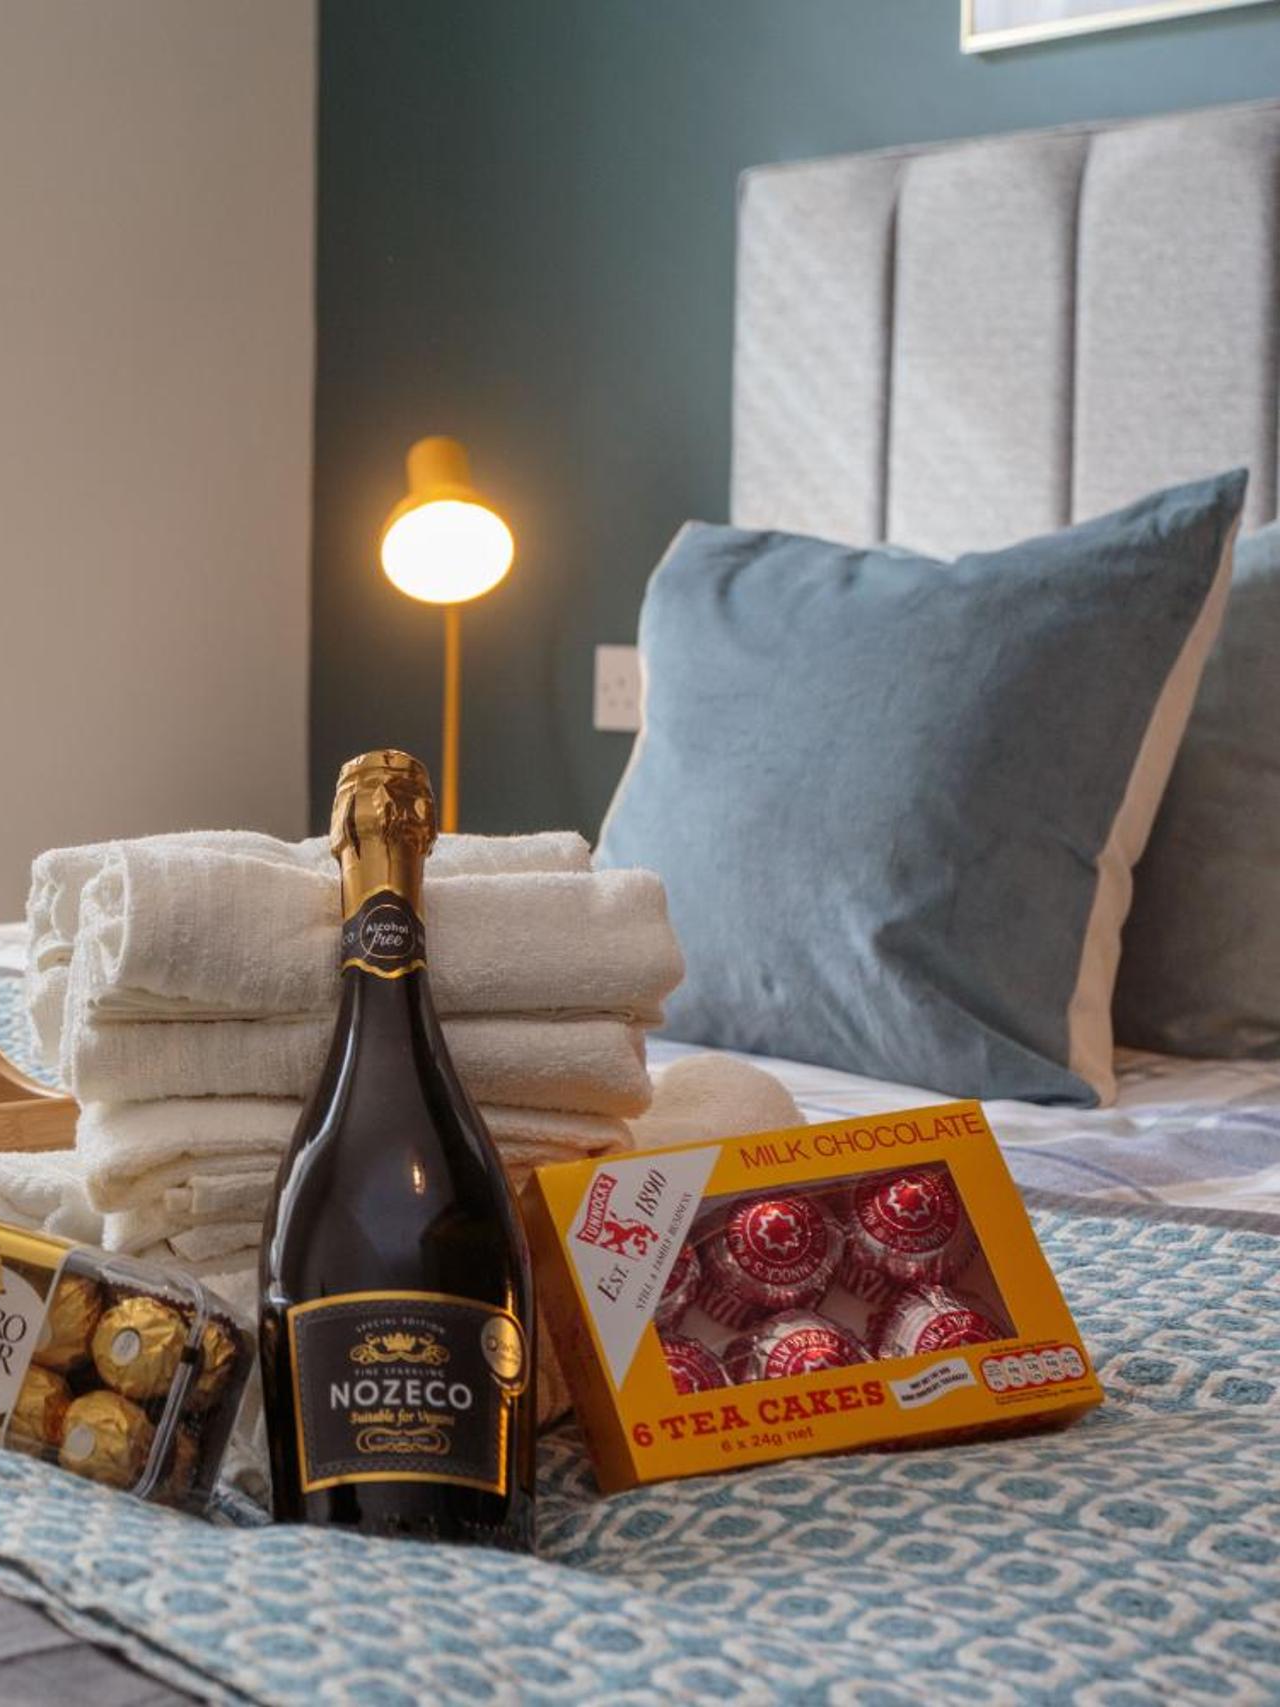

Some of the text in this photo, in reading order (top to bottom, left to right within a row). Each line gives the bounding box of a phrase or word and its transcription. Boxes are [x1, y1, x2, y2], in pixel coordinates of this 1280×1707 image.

[740, 1111, 985, 1169] MILK CHOCOLATE
[635, 1168, 667, 1217] 1890
[330, 1379, 473, 1410] NOZECO
[632, 1422, 655, 1448] 6
[659, 1405, 750, 1440] TEA
[758, 1380, 887, 1425] CAKES
[721, 1426, 815, 1453] 6 x 24g net
